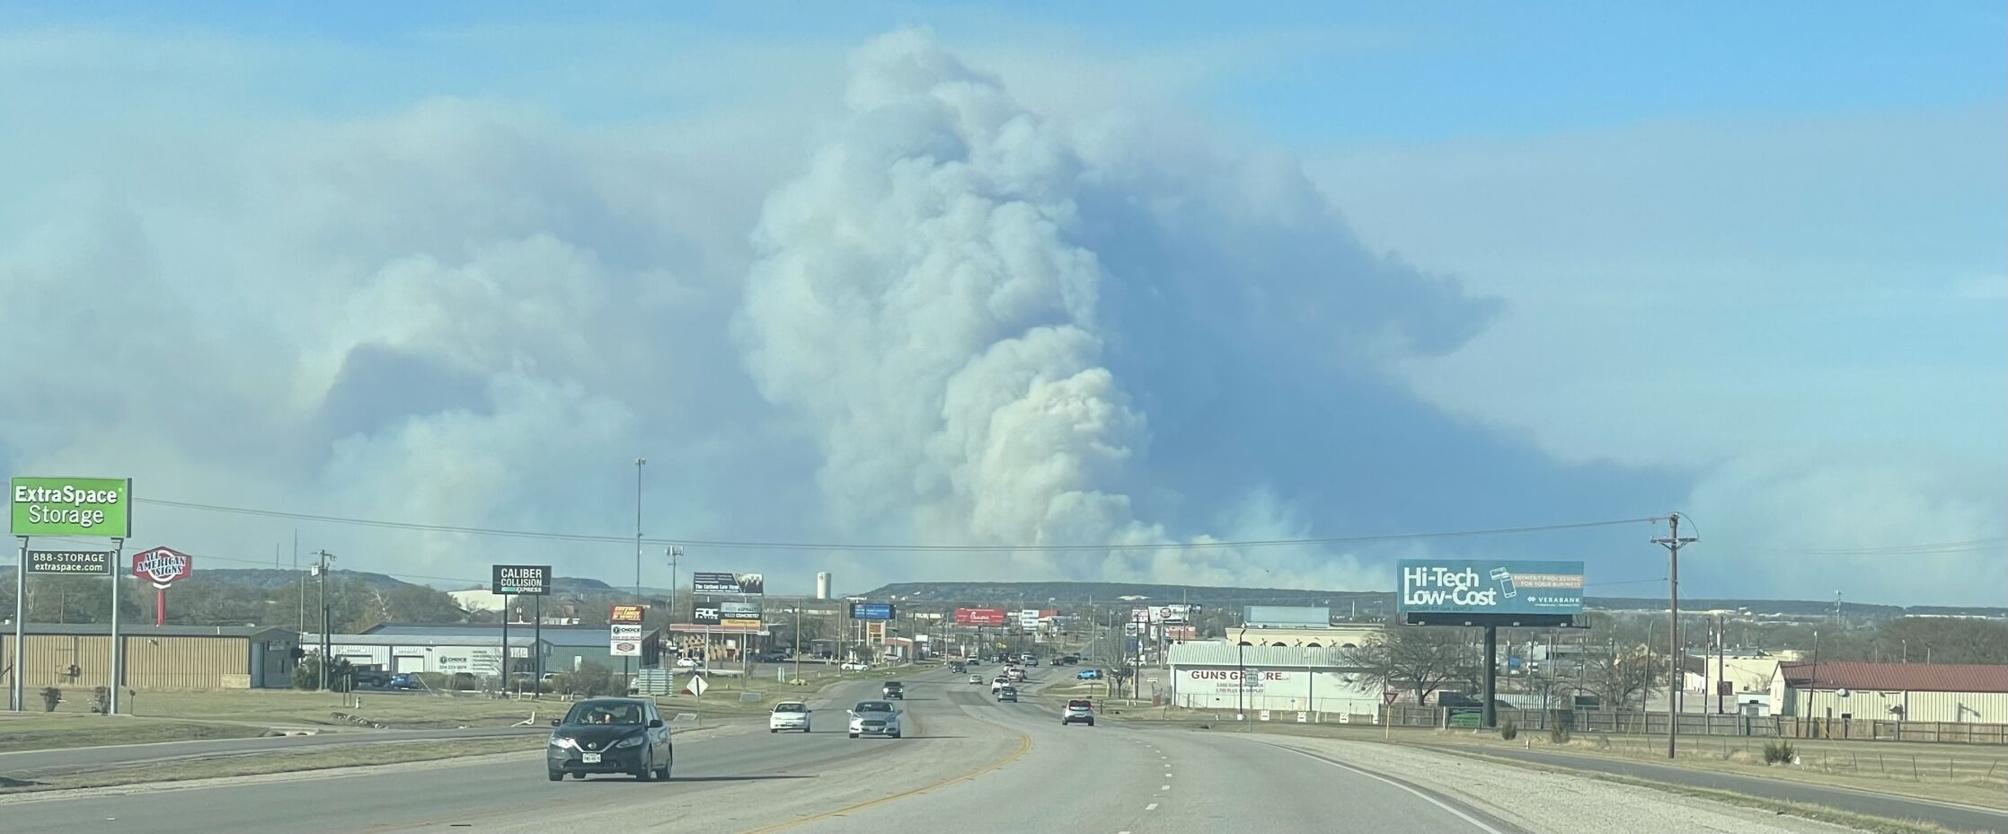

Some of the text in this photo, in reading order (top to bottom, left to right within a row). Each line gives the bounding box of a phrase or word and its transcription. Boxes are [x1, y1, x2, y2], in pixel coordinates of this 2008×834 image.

[15, 485, 117, 506] ExtraSpace
[28, 505, 104, 528] Storage
[33, 553, 104, 562] 888-STORAGE
[145, 551, 160, 562] ALL
[35, 563, 103, 572] extraspace.com
[137, 557, 186, 572] AMERICAN
[155, 565, 183, 577] SIGNS
[501, 568, 542, 578] CALIBER
[501, 578, 542, 587] COLLISION
[1403, 567, 1479, 587] Hi-Tech
[1403, 587, 1497, 606] Low-Cost
[1191, 671, 1227, 680] GUNS
